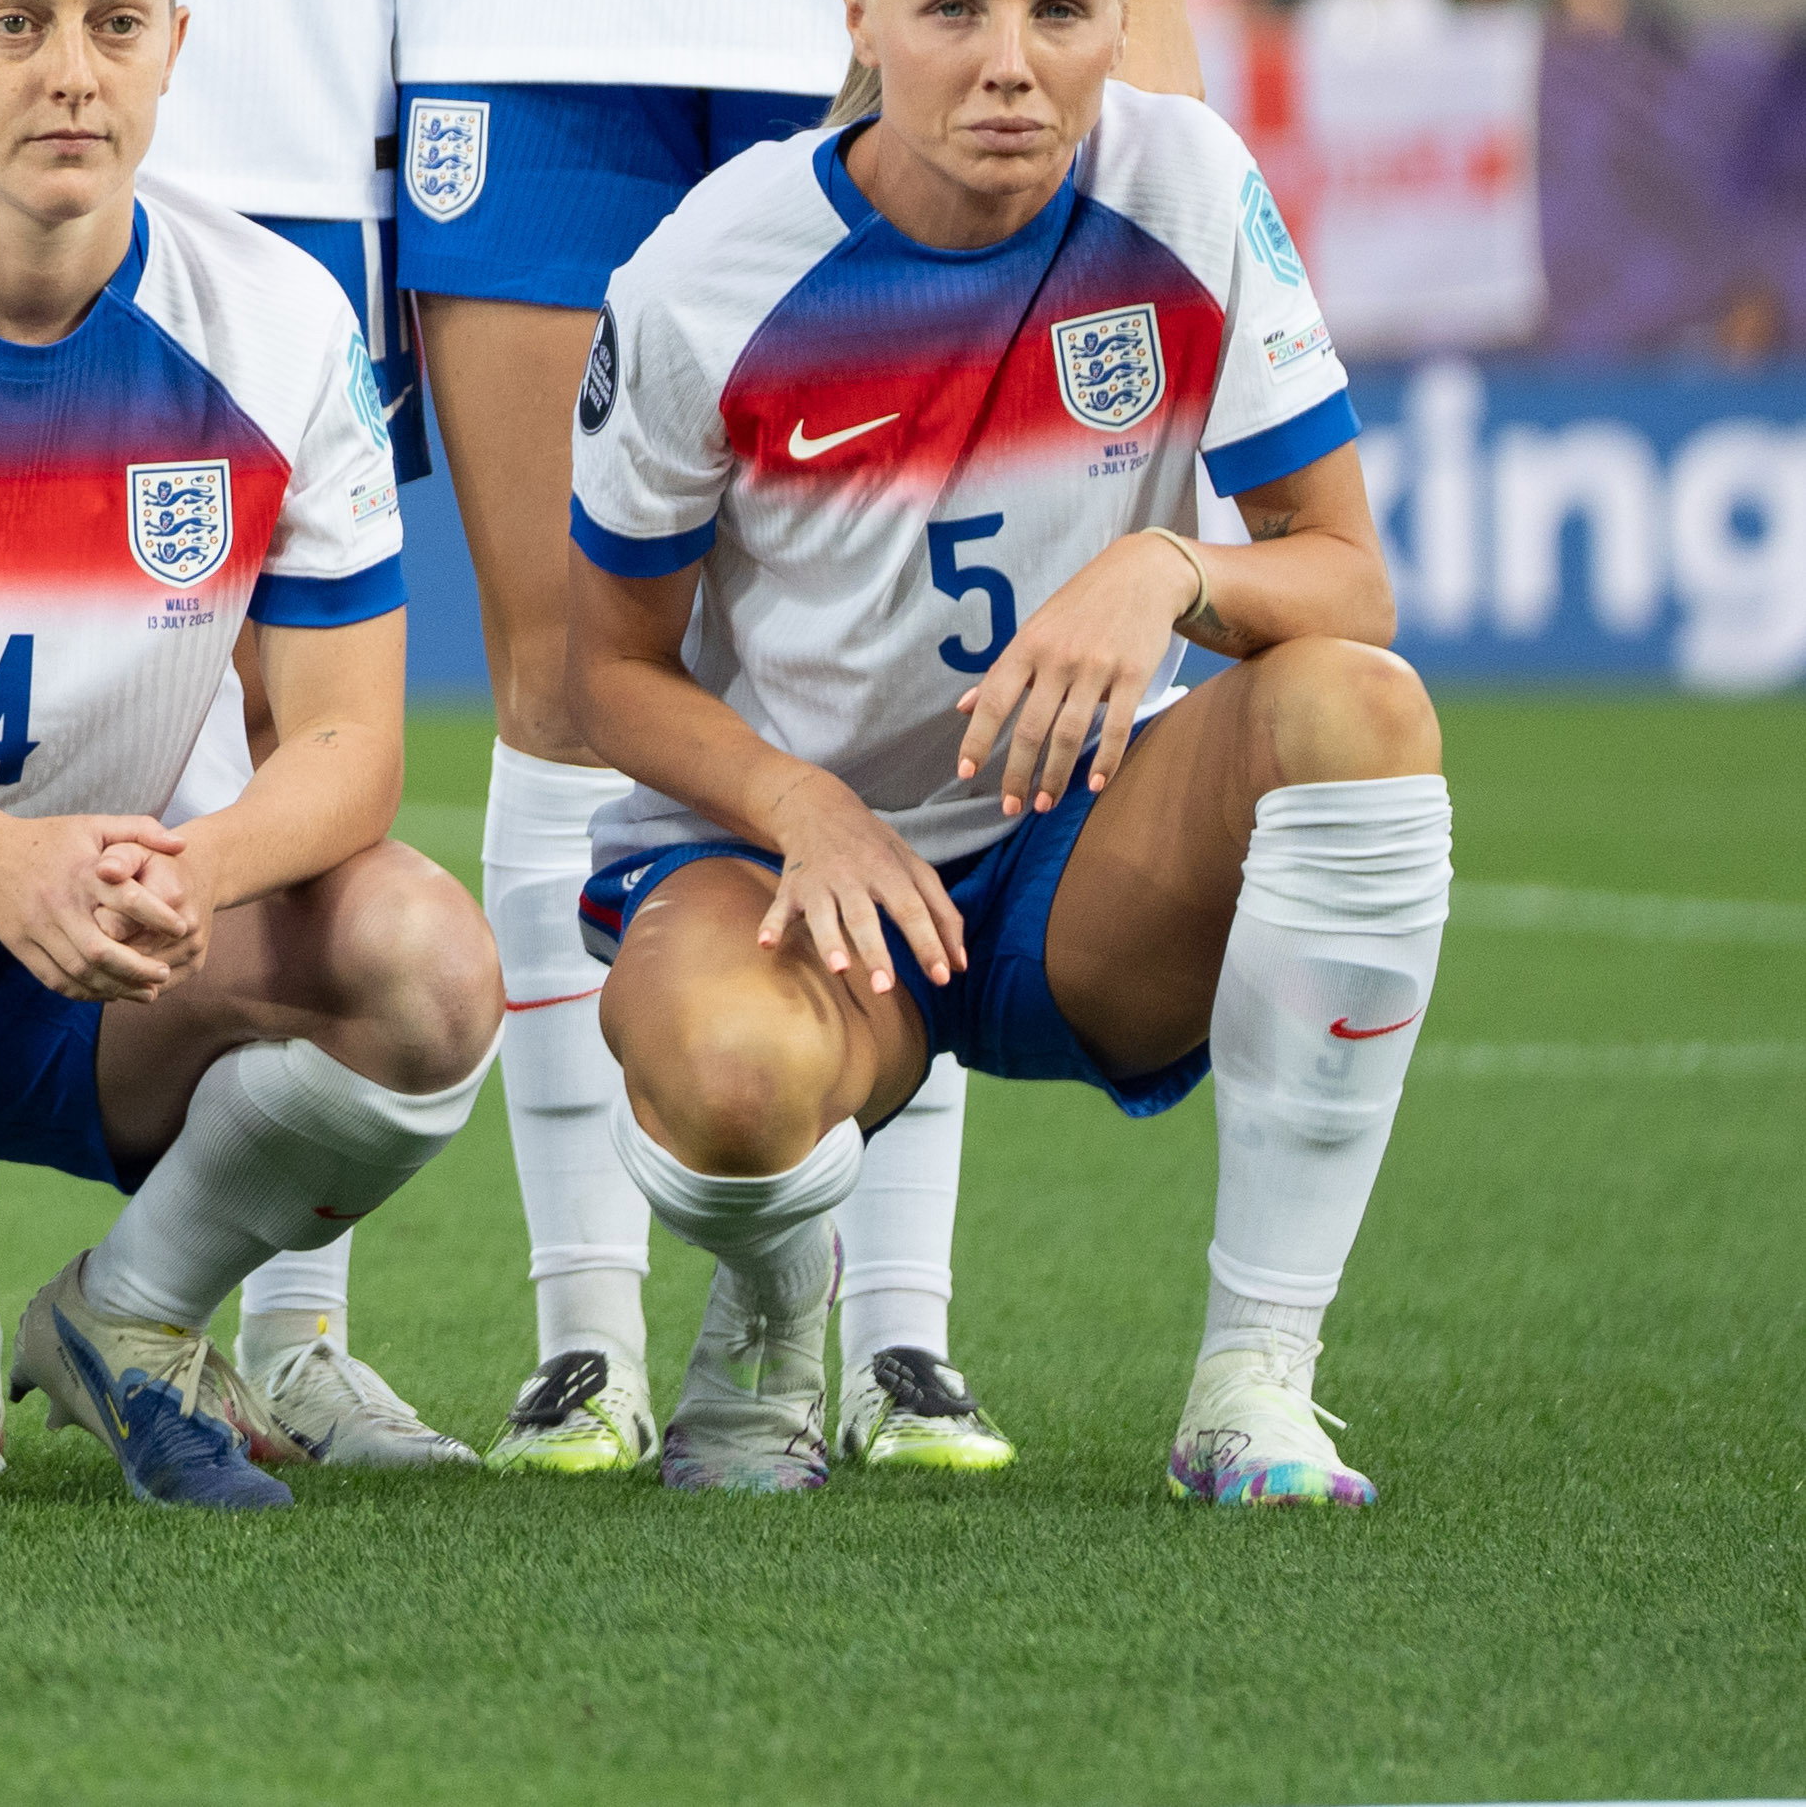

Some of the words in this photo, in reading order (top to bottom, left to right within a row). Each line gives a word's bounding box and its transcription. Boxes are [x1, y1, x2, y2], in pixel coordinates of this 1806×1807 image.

[1263, 329, 1285, 346] UEFA
[1103, 441, 1139, 457] WALES
[1088, 463, 1099, 477] 13
[1101, 460, 1126, 475] JULY
[927, 512, 1018, 674] 5
[165, 598, 200, 611] WALES
[147, 615, 158, 629] 13
[161, 615, 186, 629] JULY
[188, 611, 215, 626] 2025
